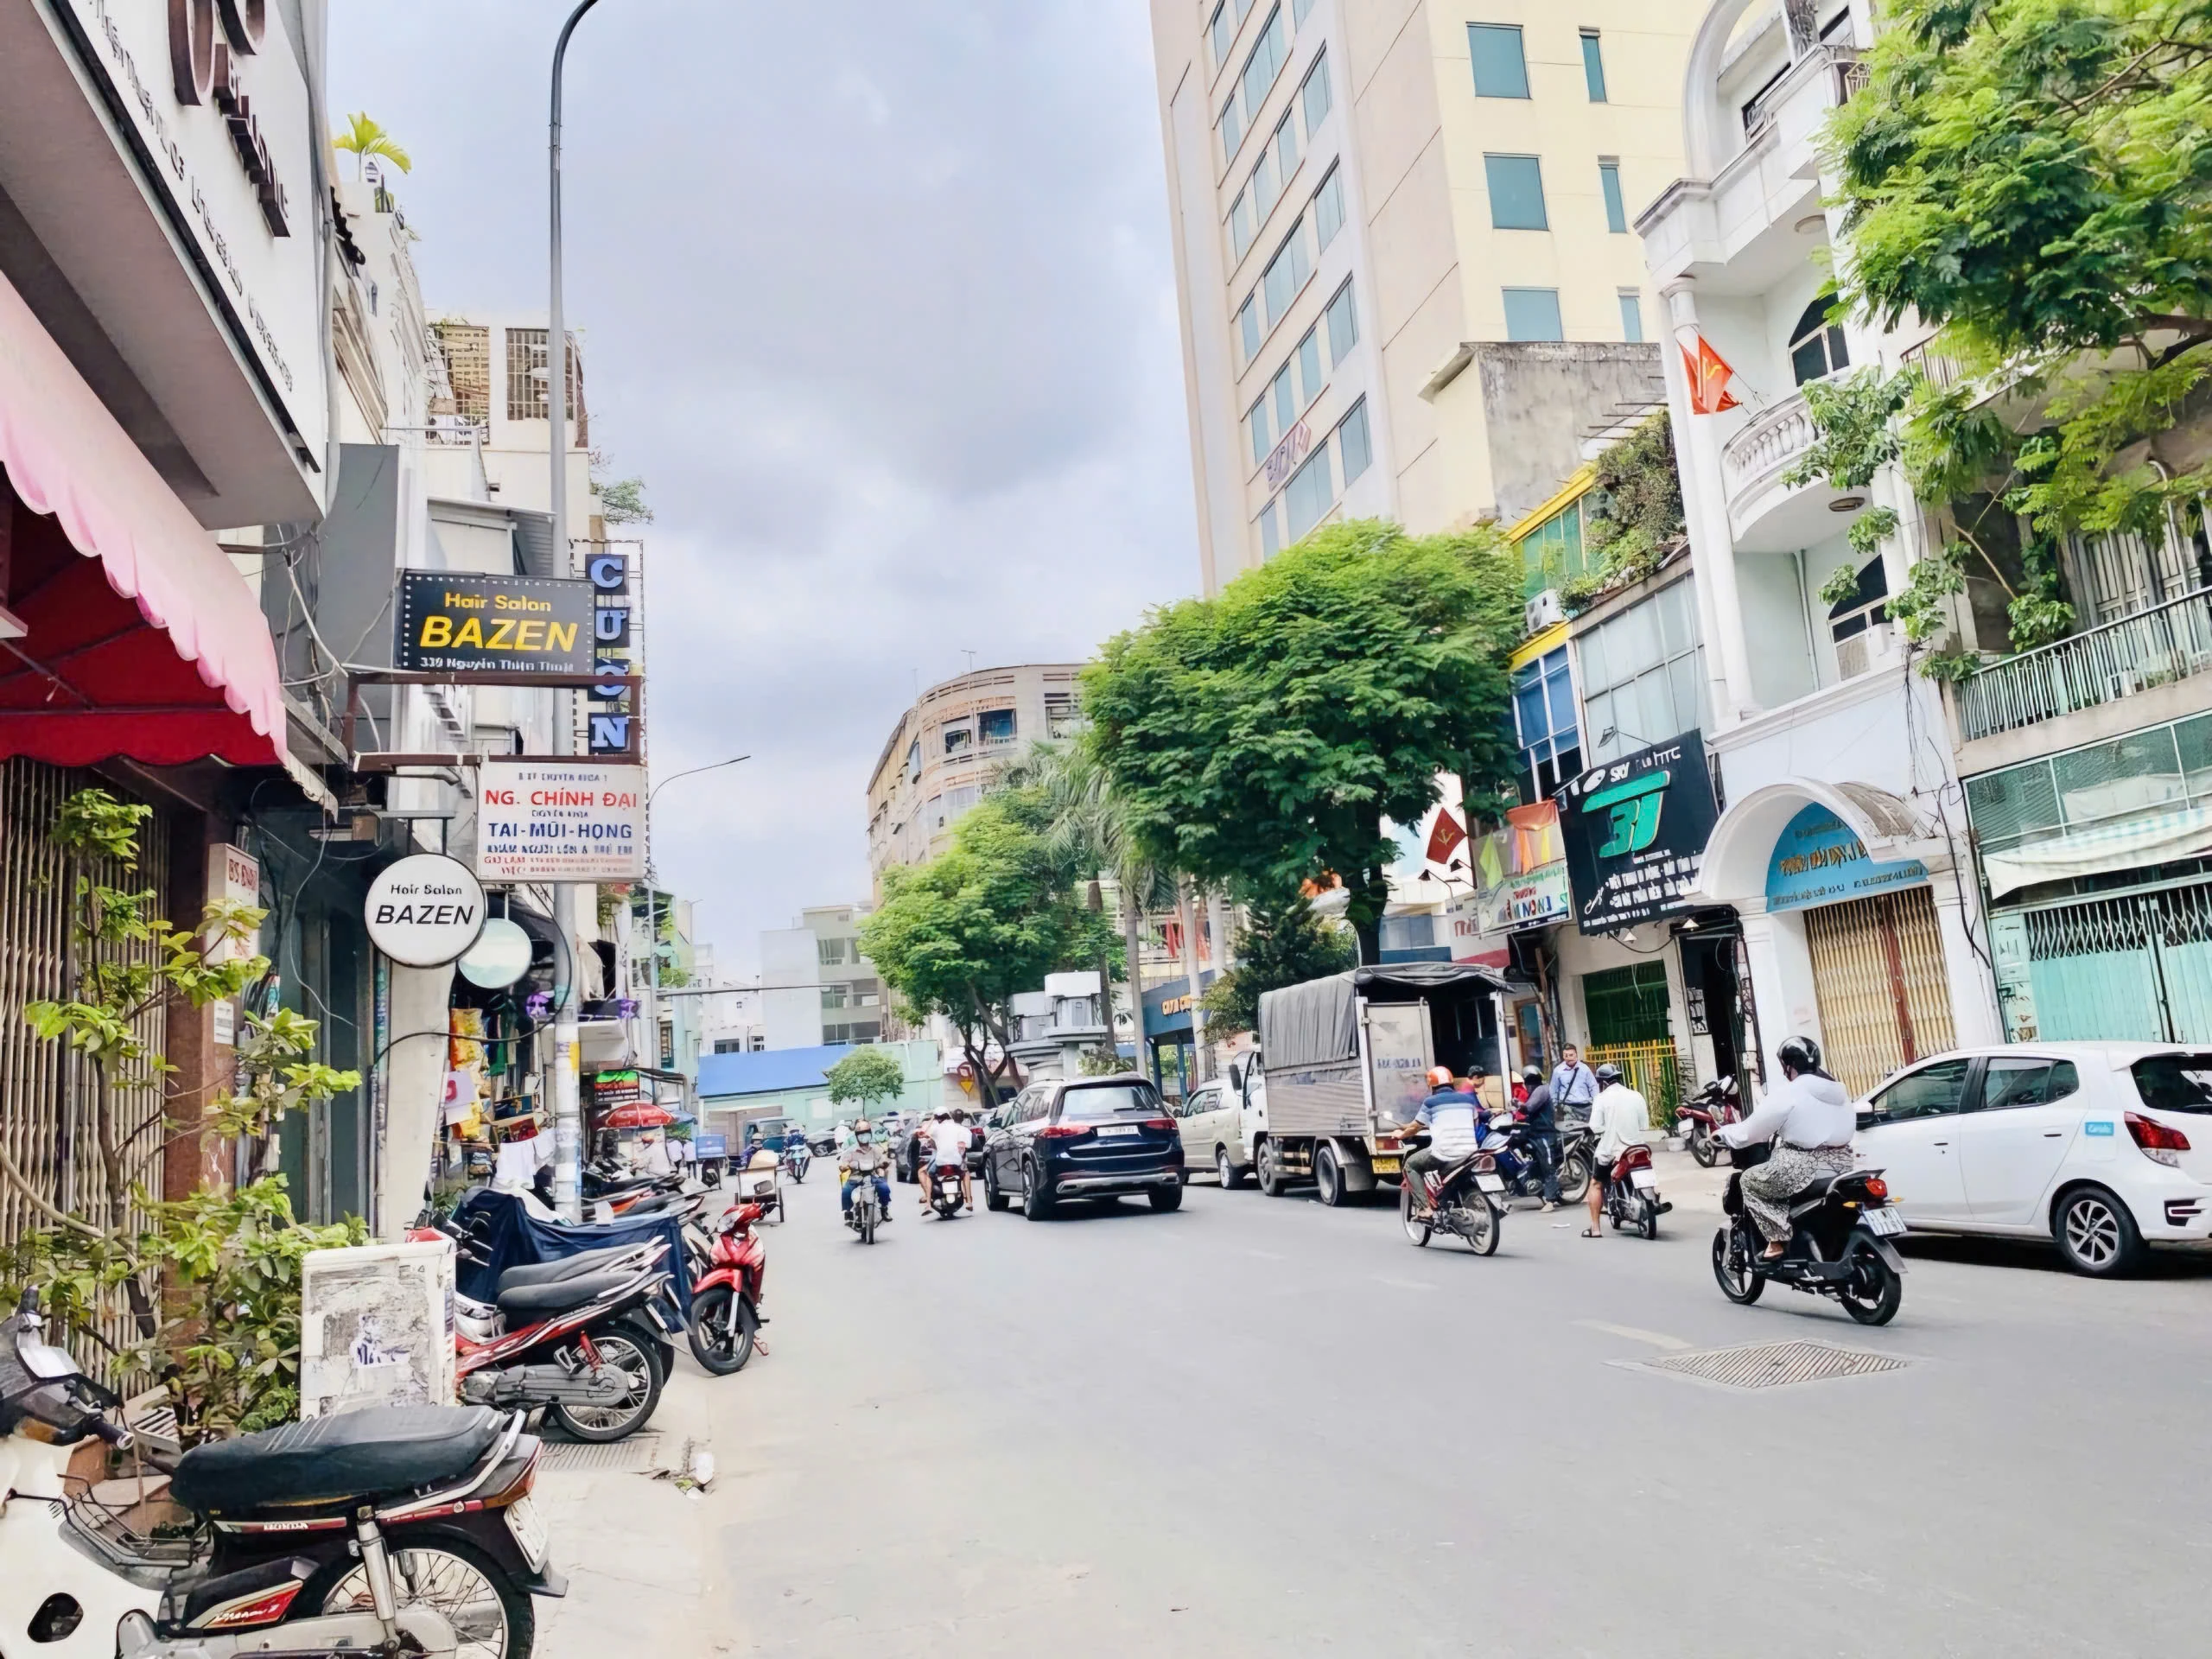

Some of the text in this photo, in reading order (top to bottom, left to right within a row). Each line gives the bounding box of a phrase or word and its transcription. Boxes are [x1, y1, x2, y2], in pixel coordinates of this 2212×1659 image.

[444, 592, 552, 613] Hair Salon
[420, 615, 578, 652] BAZEN
[485, 787, 637, 810] NG. CHÍNH ĐẠI
[390, 884, 462, 895] Hair Salon
[376, 905, 474, 925] BAZEN
